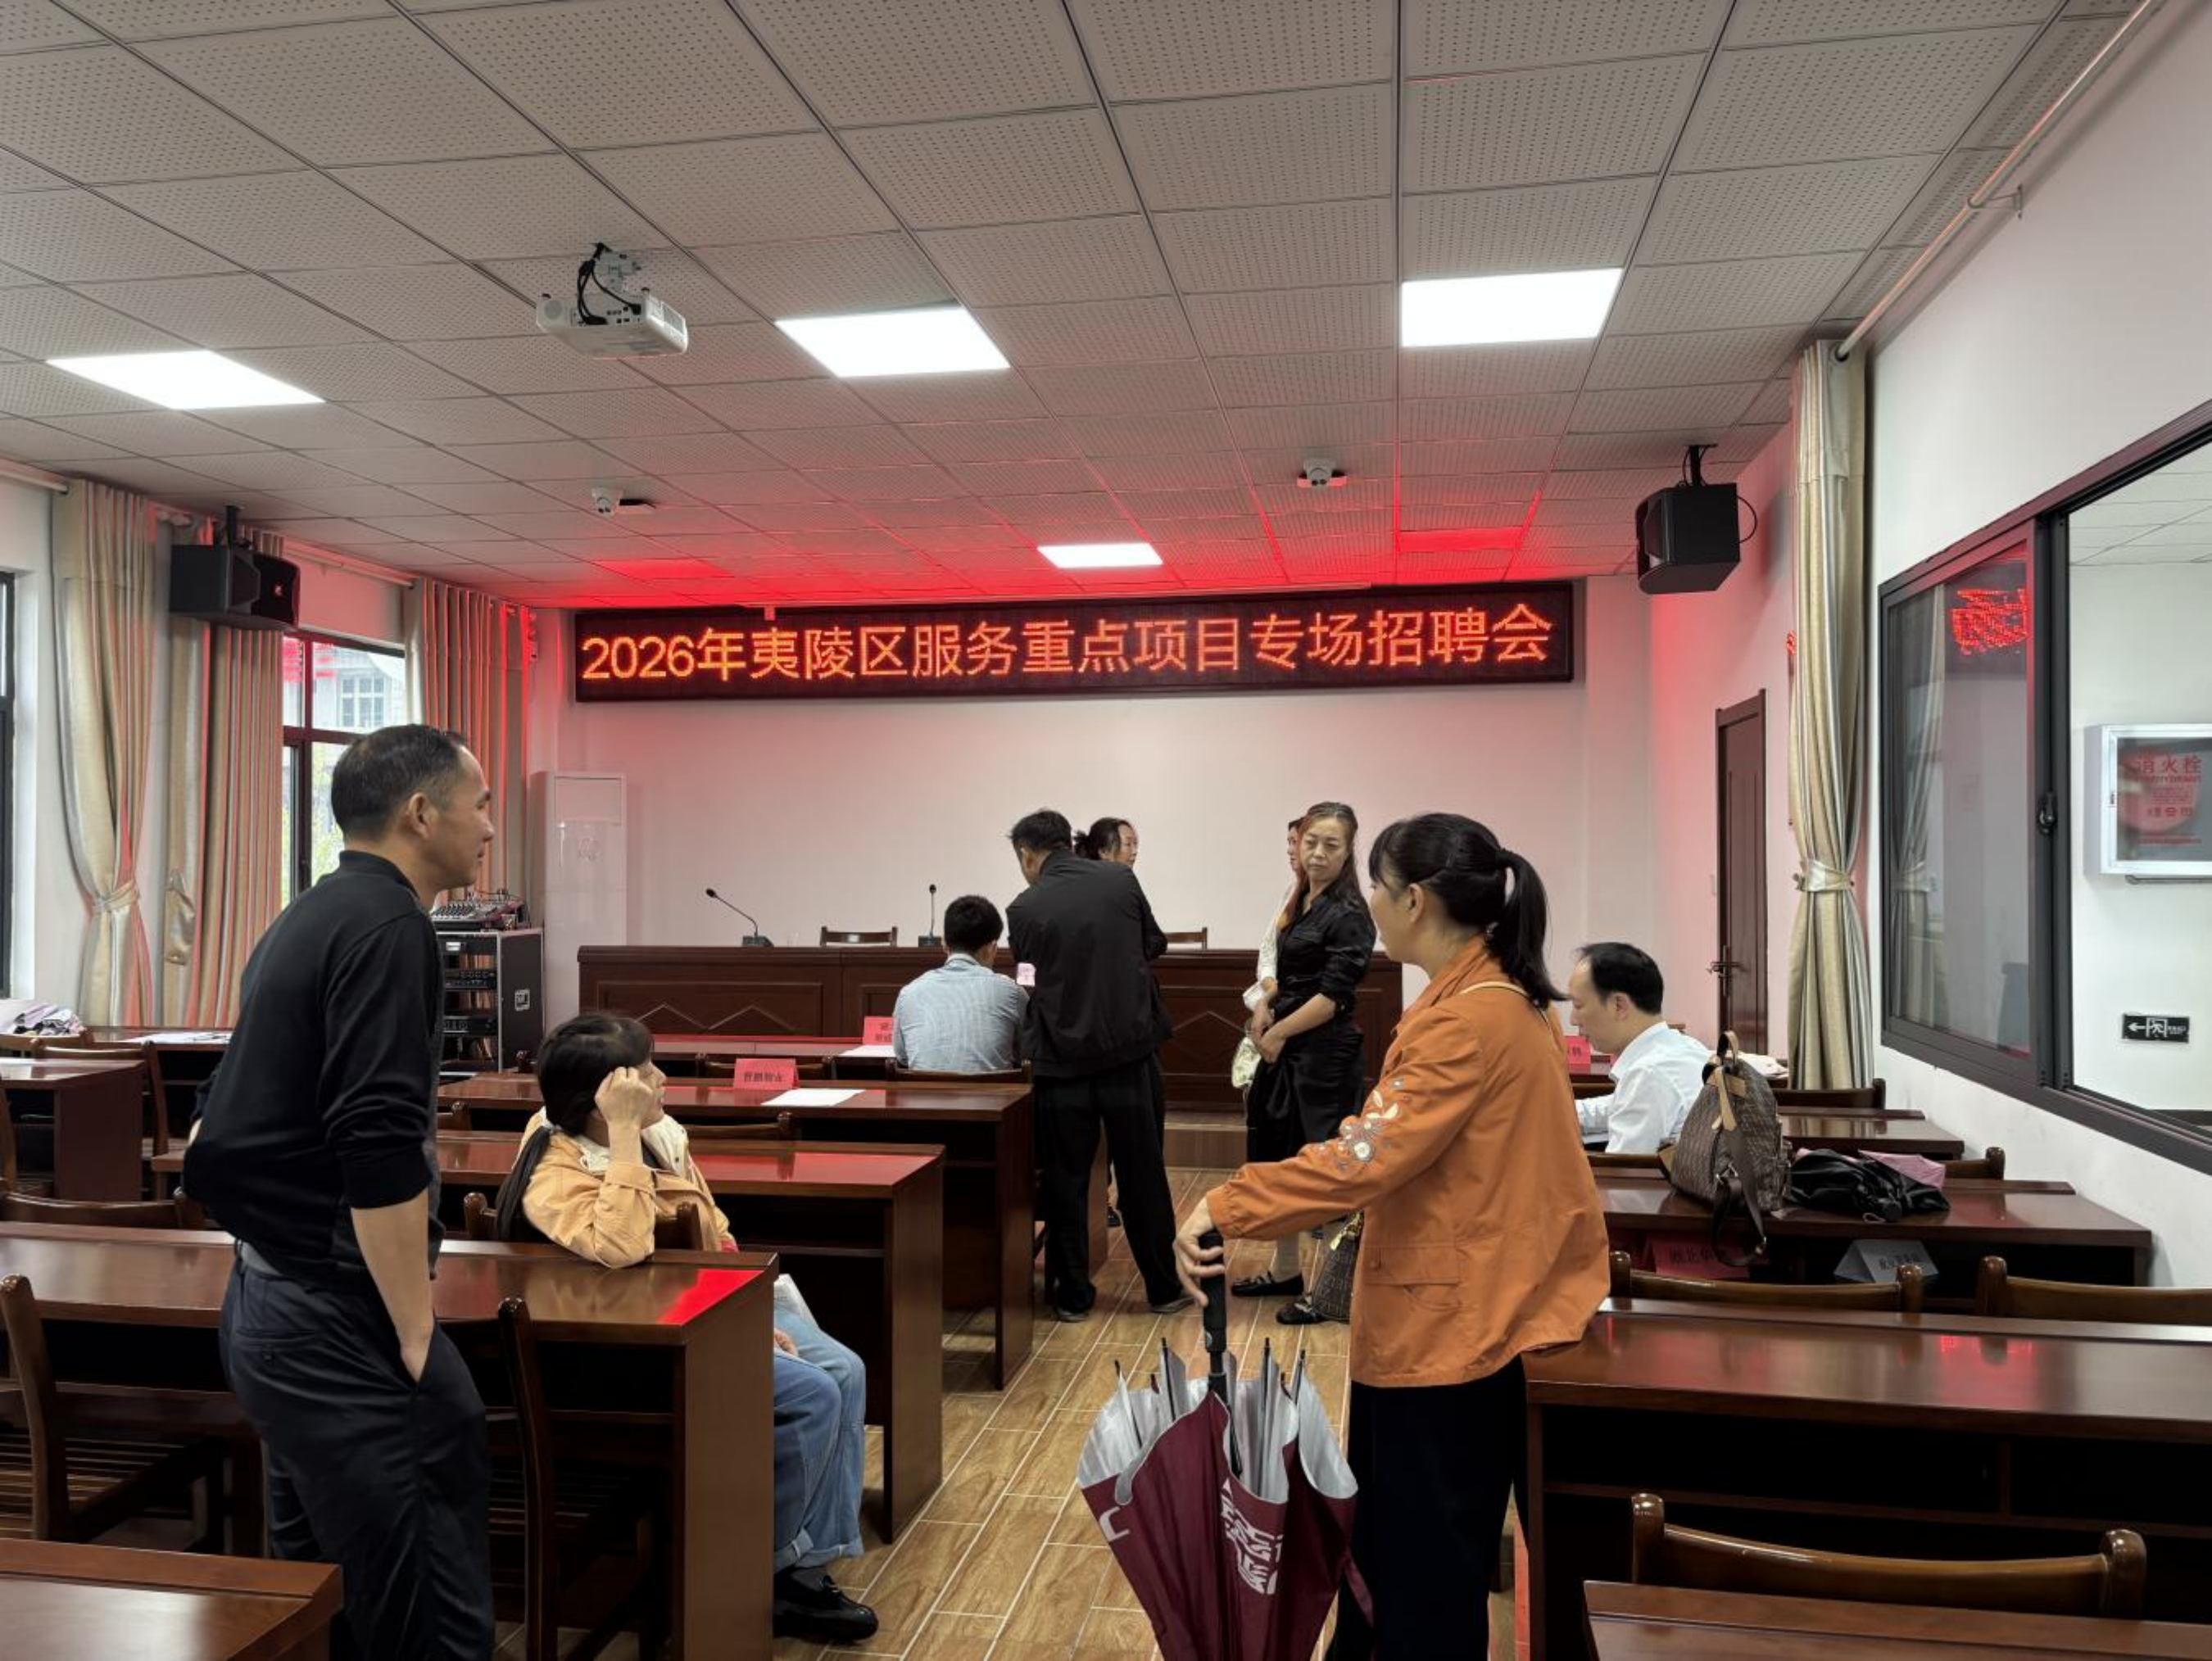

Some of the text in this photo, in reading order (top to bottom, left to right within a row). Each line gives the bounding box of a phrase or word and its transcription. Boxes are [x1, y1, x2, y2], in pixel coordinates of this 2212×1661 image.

[581, 604, 1552, 681] 2026年夷陵区服务重点项目专场招聘会
